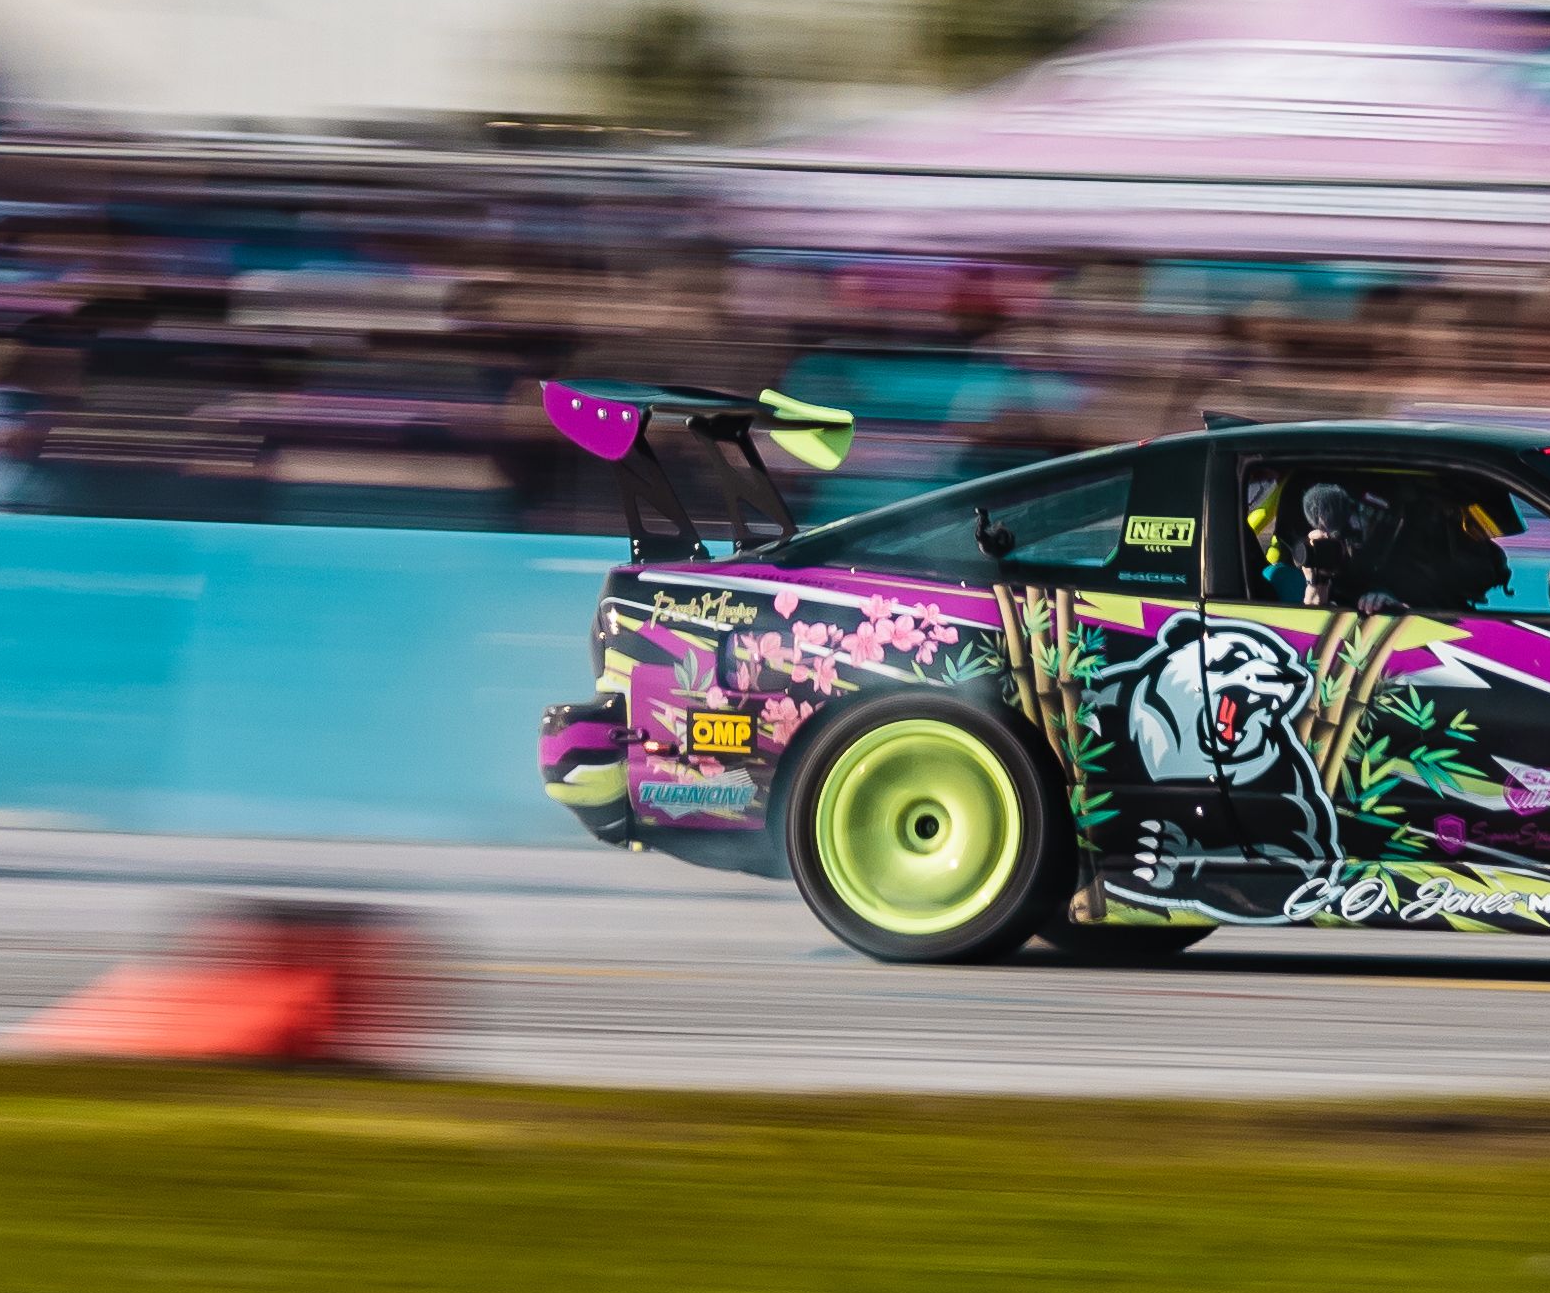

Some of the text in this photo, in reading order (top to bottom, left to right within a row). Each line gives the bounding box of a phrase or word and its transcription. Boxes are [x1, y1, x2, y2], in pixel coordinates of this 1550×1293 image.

[1132, 522, 1189, 540] NEFT
[692, 720, 751, 746] OMP
[1400, 876, 1520, 923] Jones
